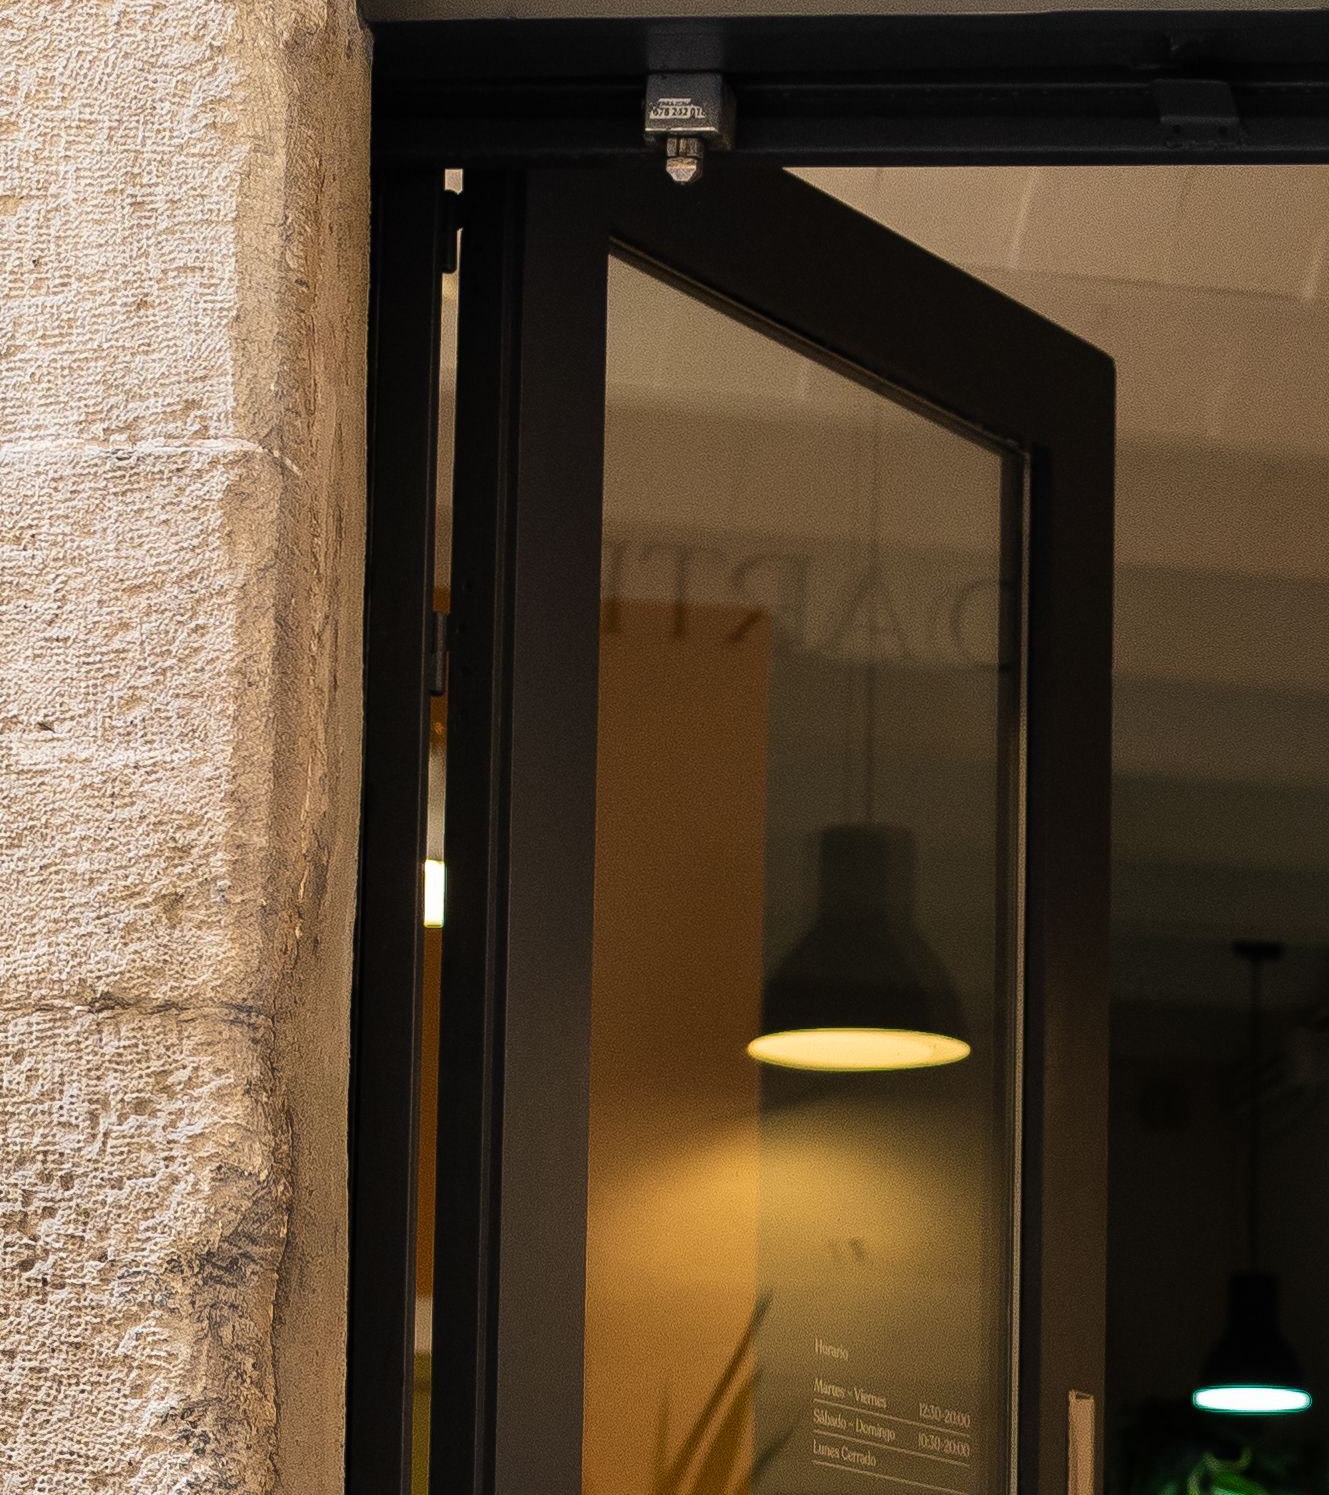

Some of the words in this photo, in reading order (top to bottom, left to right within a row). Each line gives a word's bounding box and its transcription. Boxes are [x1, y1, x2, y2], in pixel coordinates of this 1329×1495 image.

[814, 1338, 849, 1361] Horario
[813, 1377, 845, 1399] Martes
[853, 1386, 887, 1409] Viernes
[813, 1407, 847, 1430] Sábado
[855, 1418, 896, 1442] Domingo
[813, 1438, 841, 1458] Lunes
[841, 1445, 877, 1467] Cerrado
